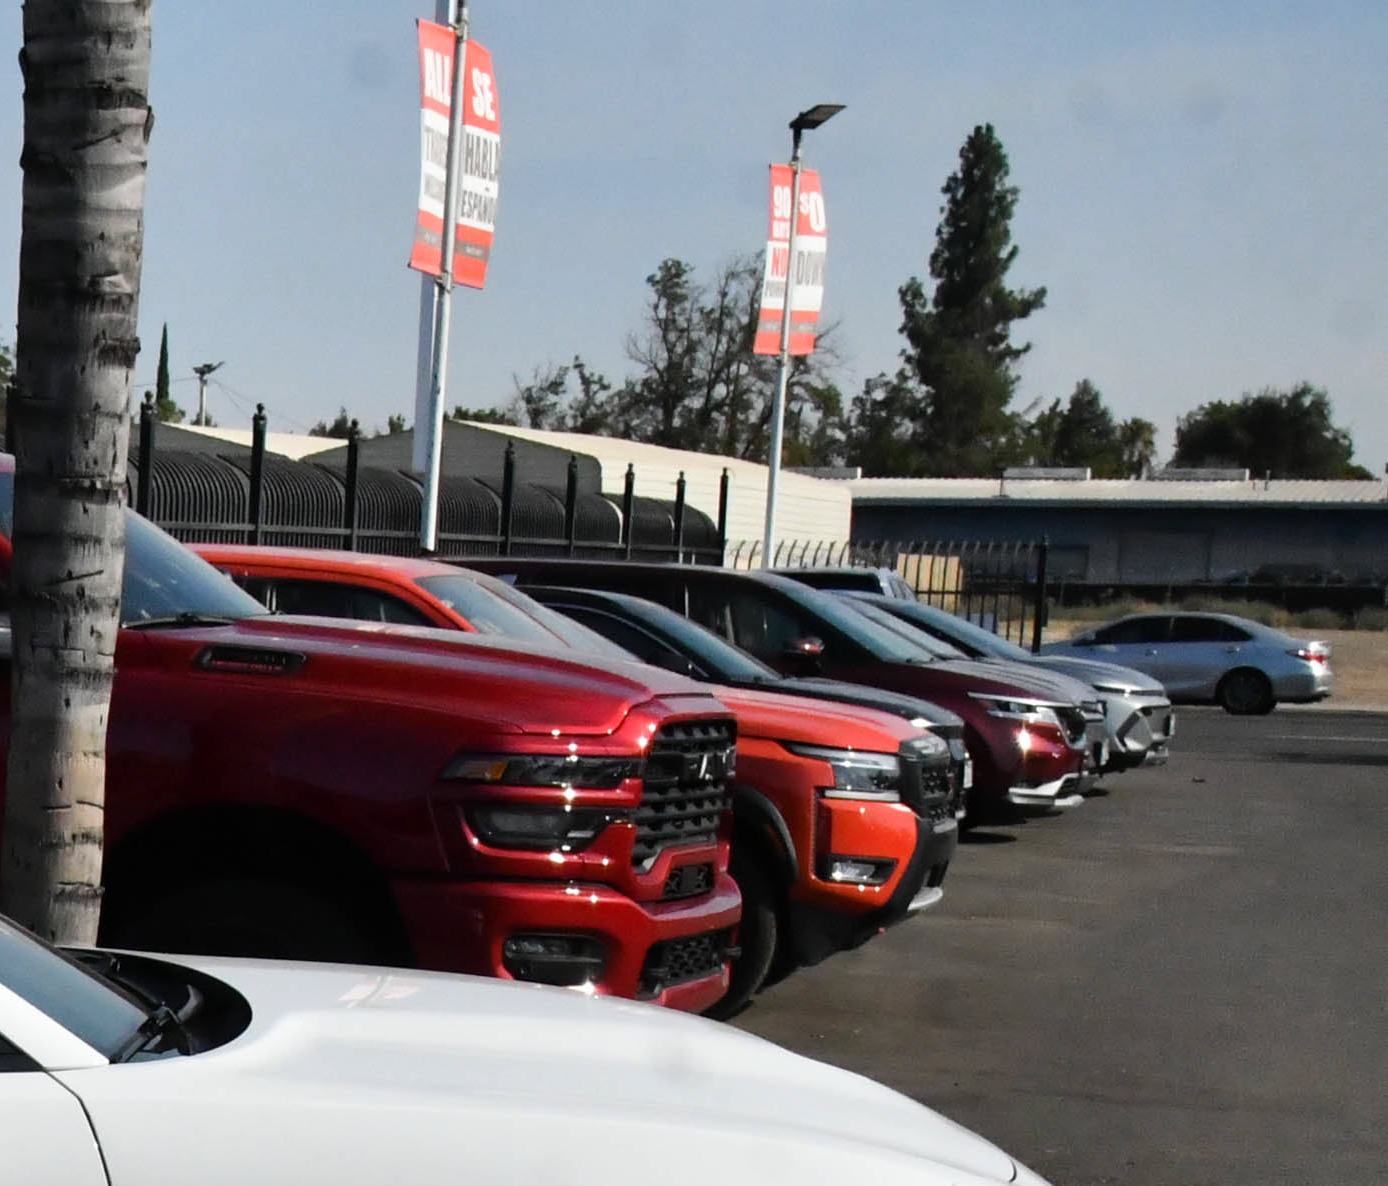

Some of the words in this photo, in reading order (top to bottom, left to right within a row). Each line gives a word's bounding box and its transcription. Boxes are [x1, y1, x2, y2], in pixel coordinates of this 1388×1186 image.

[471, 67, 496, 121] SE
[773, 185, 792, 219] 90
[799, 191, 825, 233] $0
